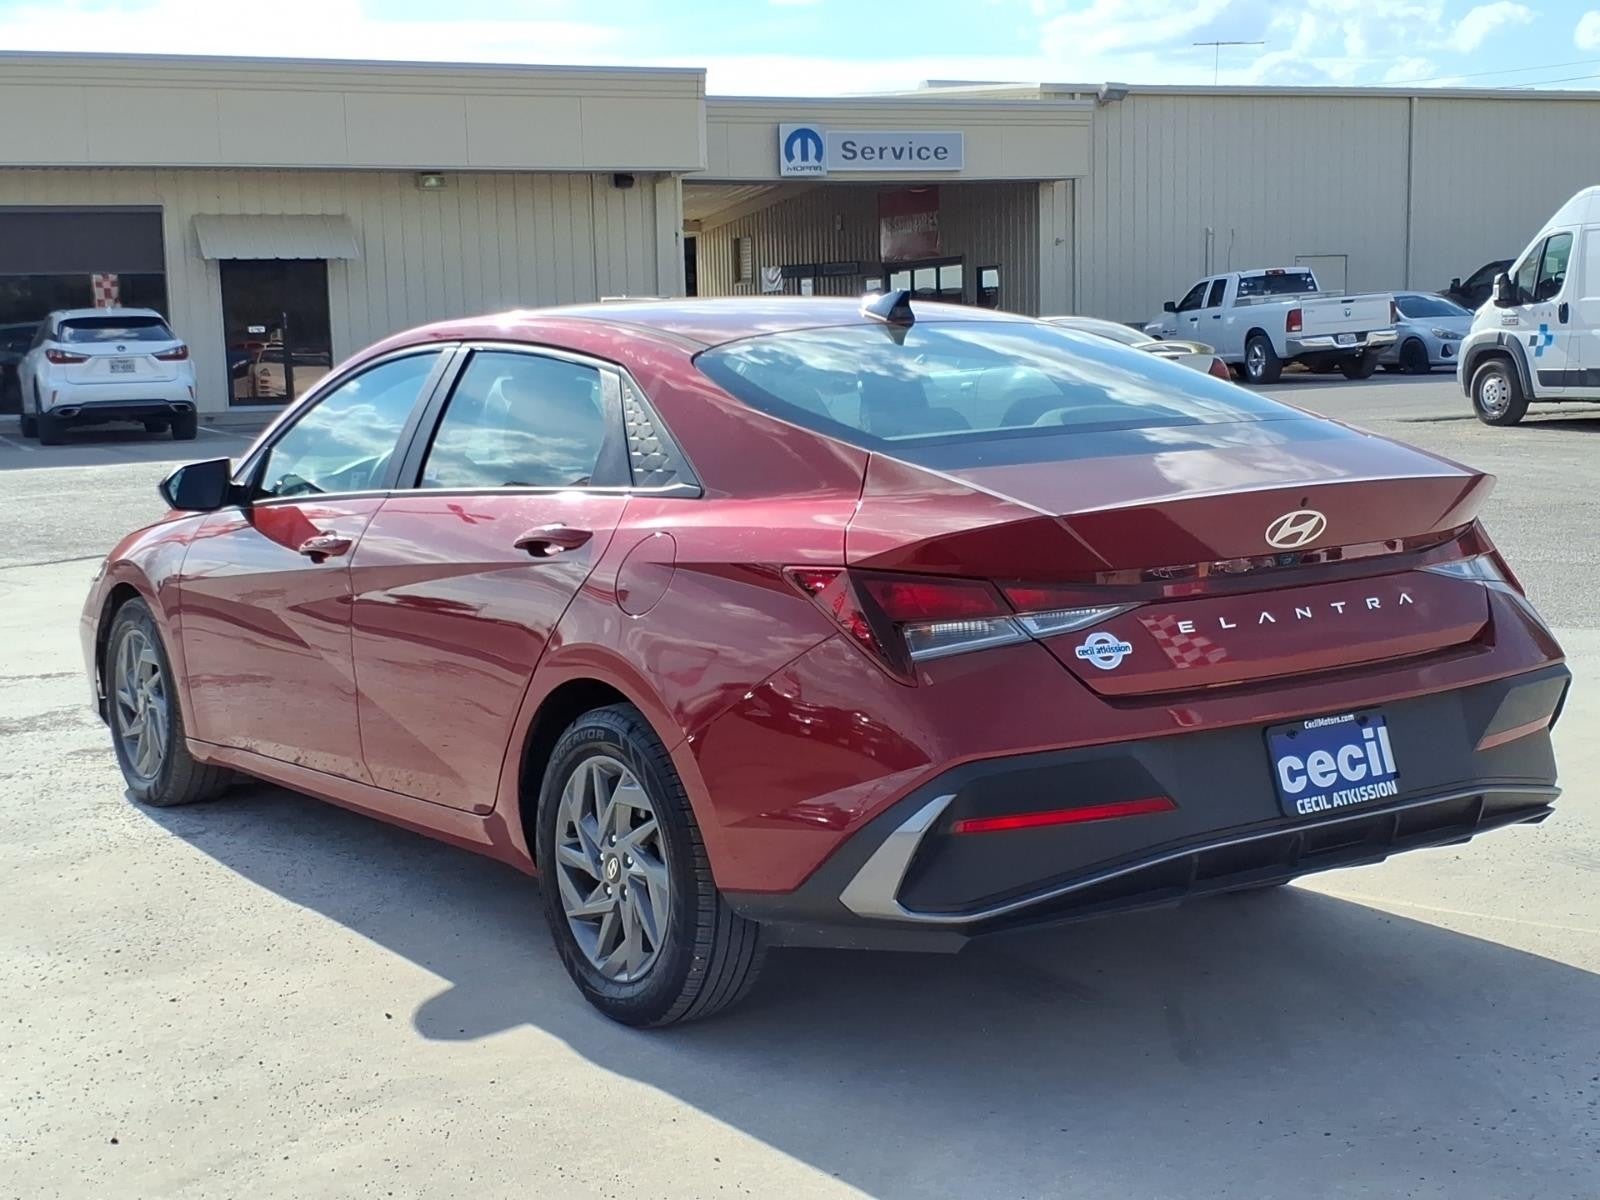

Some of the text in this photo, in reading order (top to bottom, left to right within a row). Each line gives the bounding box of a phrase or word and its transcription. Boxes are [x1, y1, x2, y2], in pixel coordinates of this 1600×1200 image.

[841, 140, 949, 161] Service
[1177, 592, 1413, 634] ELANTRA
[1078, 646, 1095, 656] cecil
[1304, 714, 1354, 729] CecilMotors.com
[1277, 726, 1397, 794] cecil
[1296, 781, 1398, 815] CECIL ATKISSION
